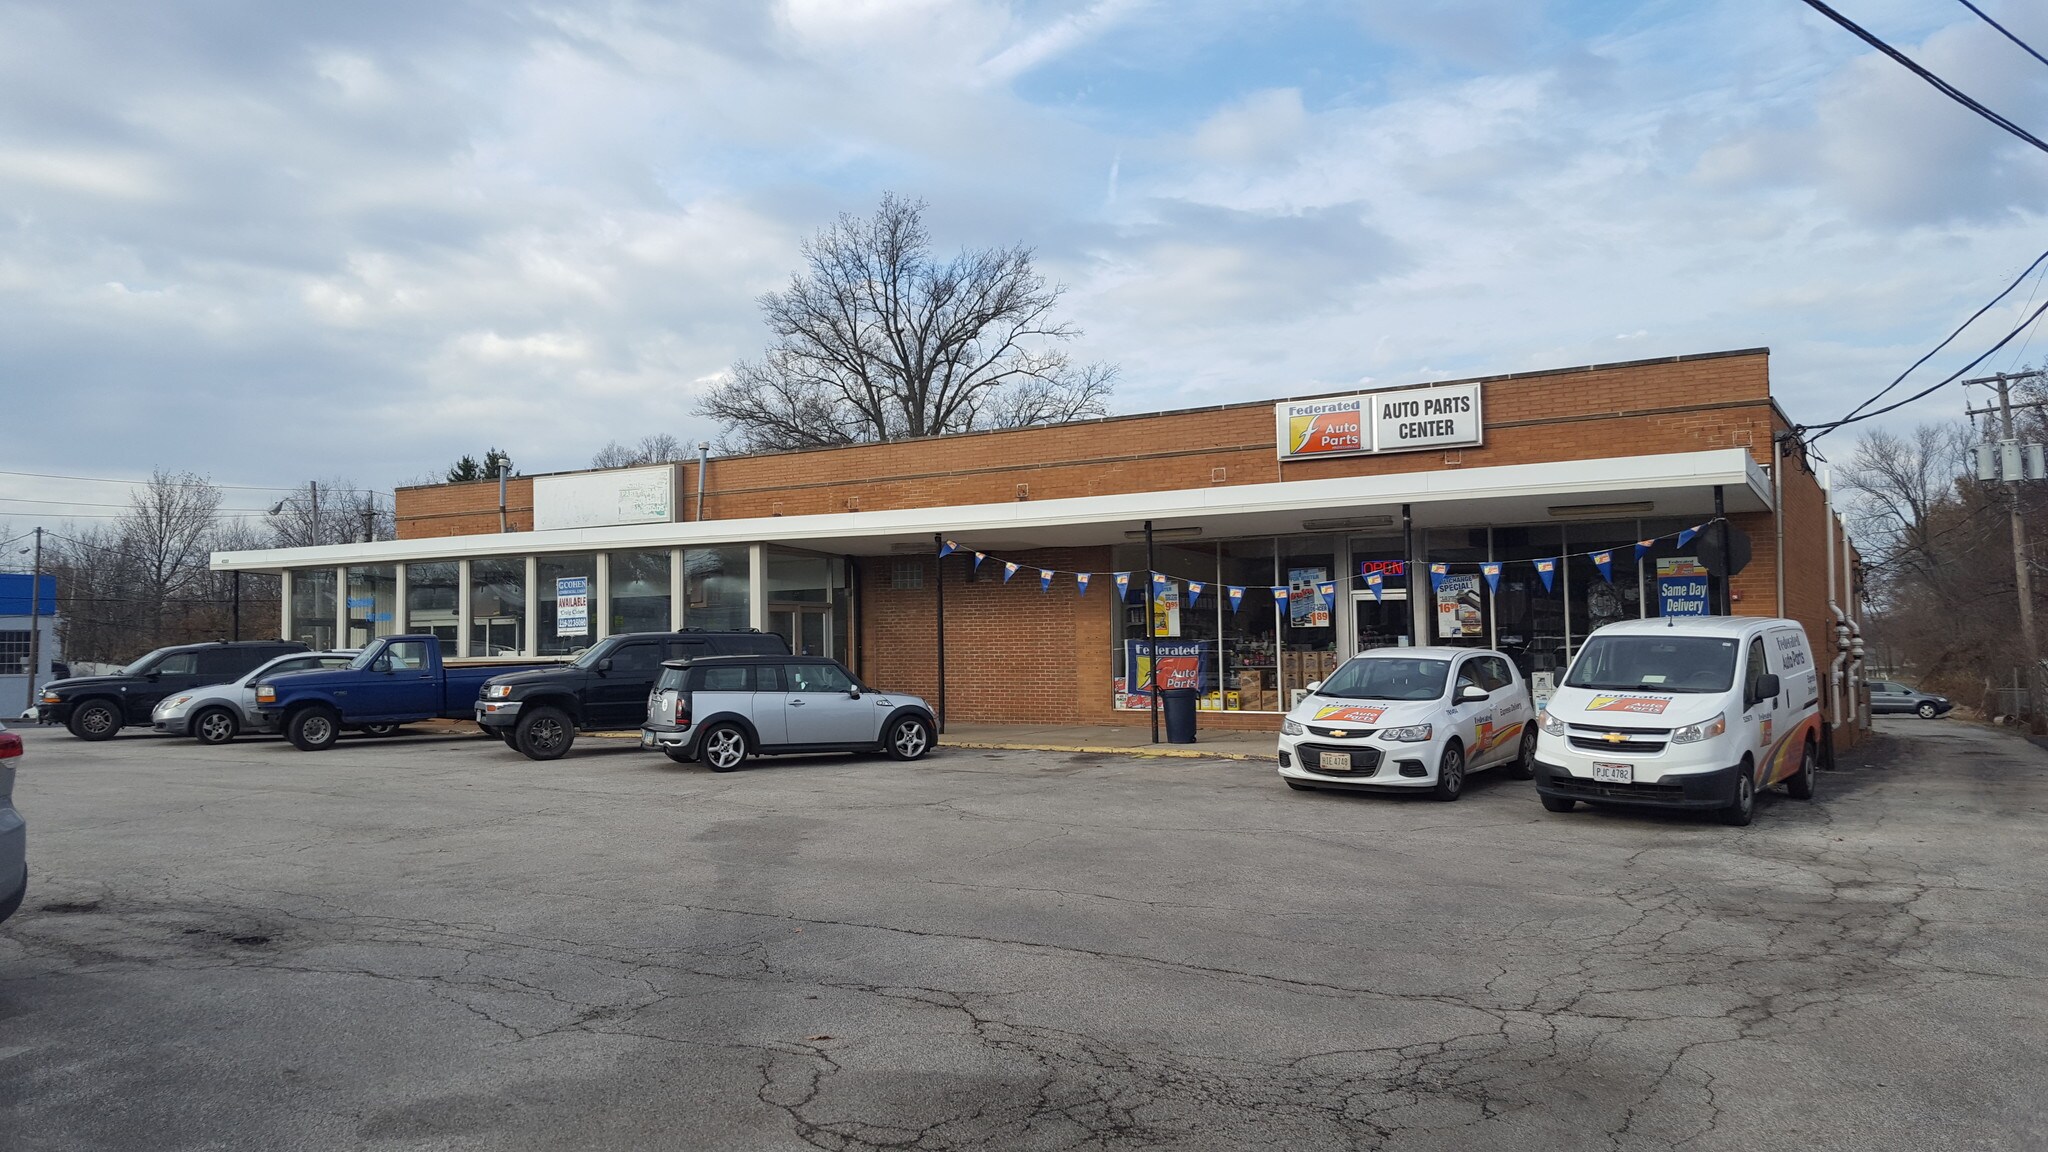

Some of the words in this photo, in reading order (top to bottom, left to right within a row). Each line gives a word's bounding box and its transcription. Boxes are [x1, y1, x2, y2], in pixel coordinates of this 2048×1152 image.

[1289, 400, 1360, 415] Federated
[1383, 401, 1419, 419] AUTO
[1424, 396, 1470, 415] PARTS
[1325, 422, 1358, 433] Auto
[1399, 419, 1454, 439] CENTER
[1321, 434, 1359, 446] Parts
[1363, 561, 1403, 575] OPEN
[1440, 582, 1473, 592] SPECIAL!
[1661, 583, 1687, 597] Same
[1689, 582, 1707, 598] Day
[559, 597, 586, 607] AVAILABLE
[1667, 598, 1704, 614] Delivery
[1171, 669, 1196, 678] Auto
[1167, 678, 1196, 688] Parts
[1344, 713, 1374, 721] Parts
[1596, 767, 1610, 777] PJC
[1611, 769, 1629, 779] 4782
